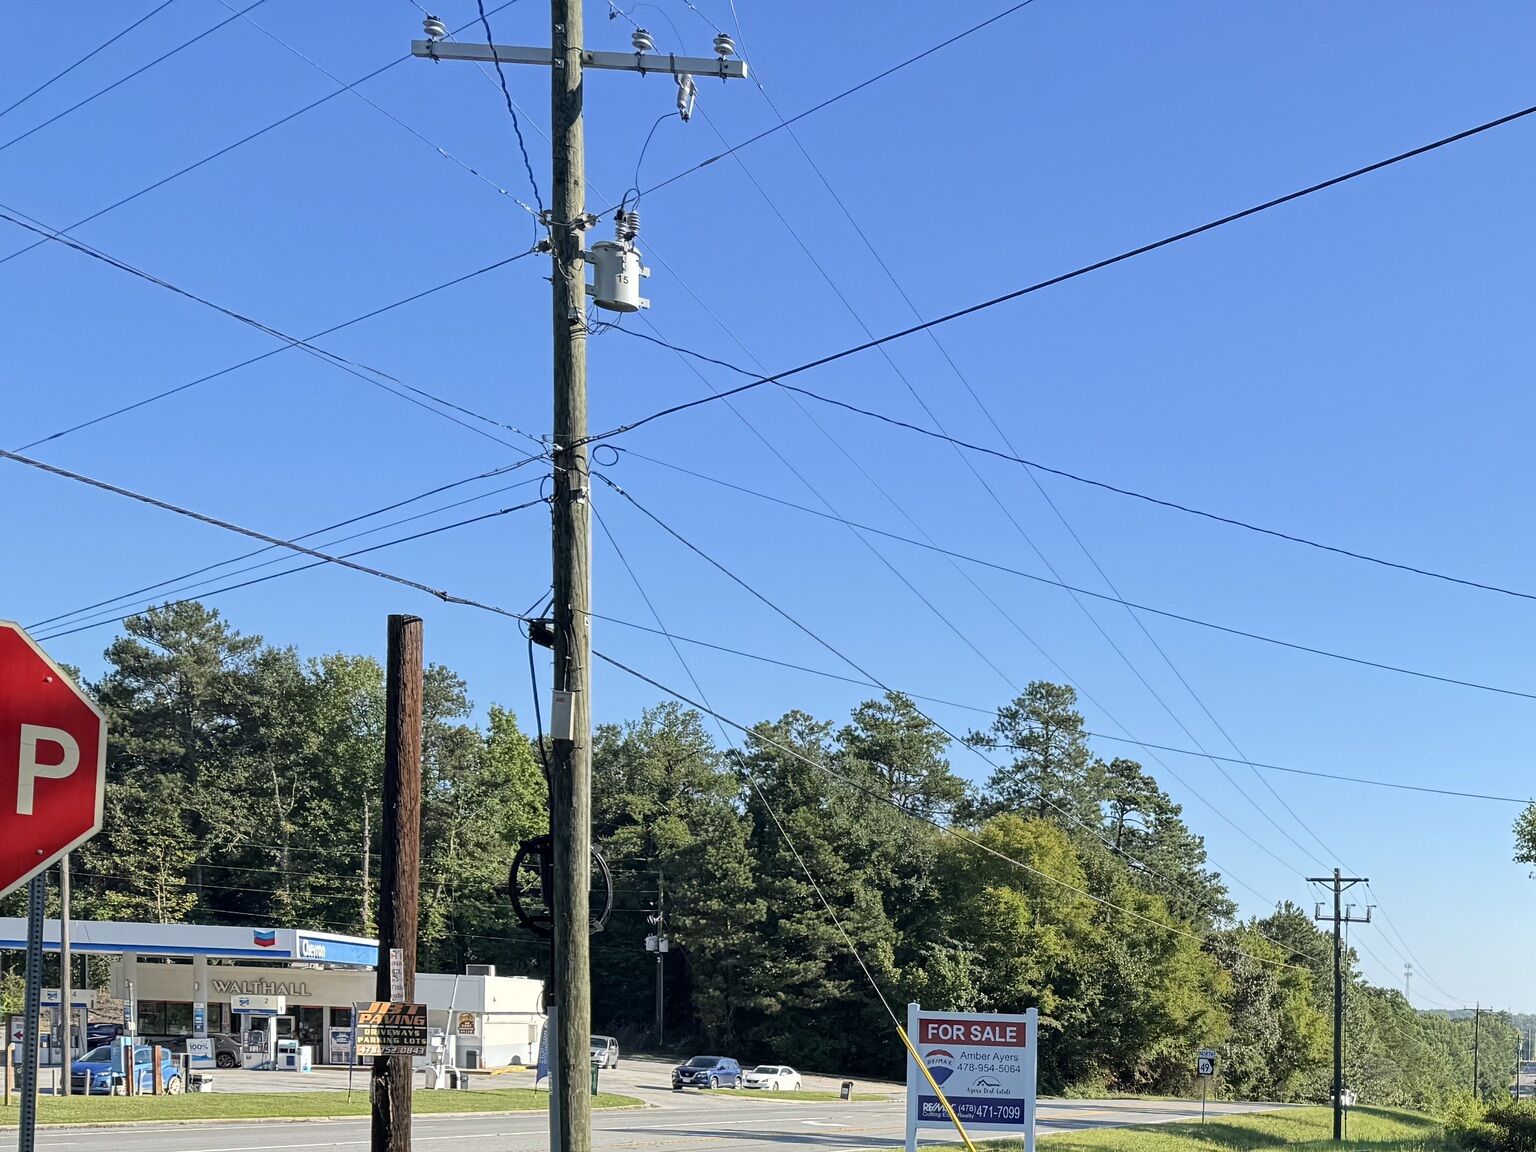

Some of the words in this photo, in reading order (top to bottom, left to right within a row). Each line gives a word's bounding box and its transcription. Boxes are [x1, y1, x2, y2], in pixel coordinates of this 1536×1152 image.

[616, 274, 629, 284] 15
[212, 979, 312, 997] WALTHALL
[358, 1013, 426, 1025] PAVING
[364, 1028, 420, 1037] DRIVEWAYS
[928, 1024, 965, 1040] FOR
[970, 1025, 1017, 1042] SALE
[357, 1036, 400, 1044] PARKING
[960, 1051, 990, 1060] Amber
[992, 1052, 1019, 1063] Ayers
[957, 1063, 1021, 1073] 478-954-5064
[1201, 1063, 1210, 1072] 49
